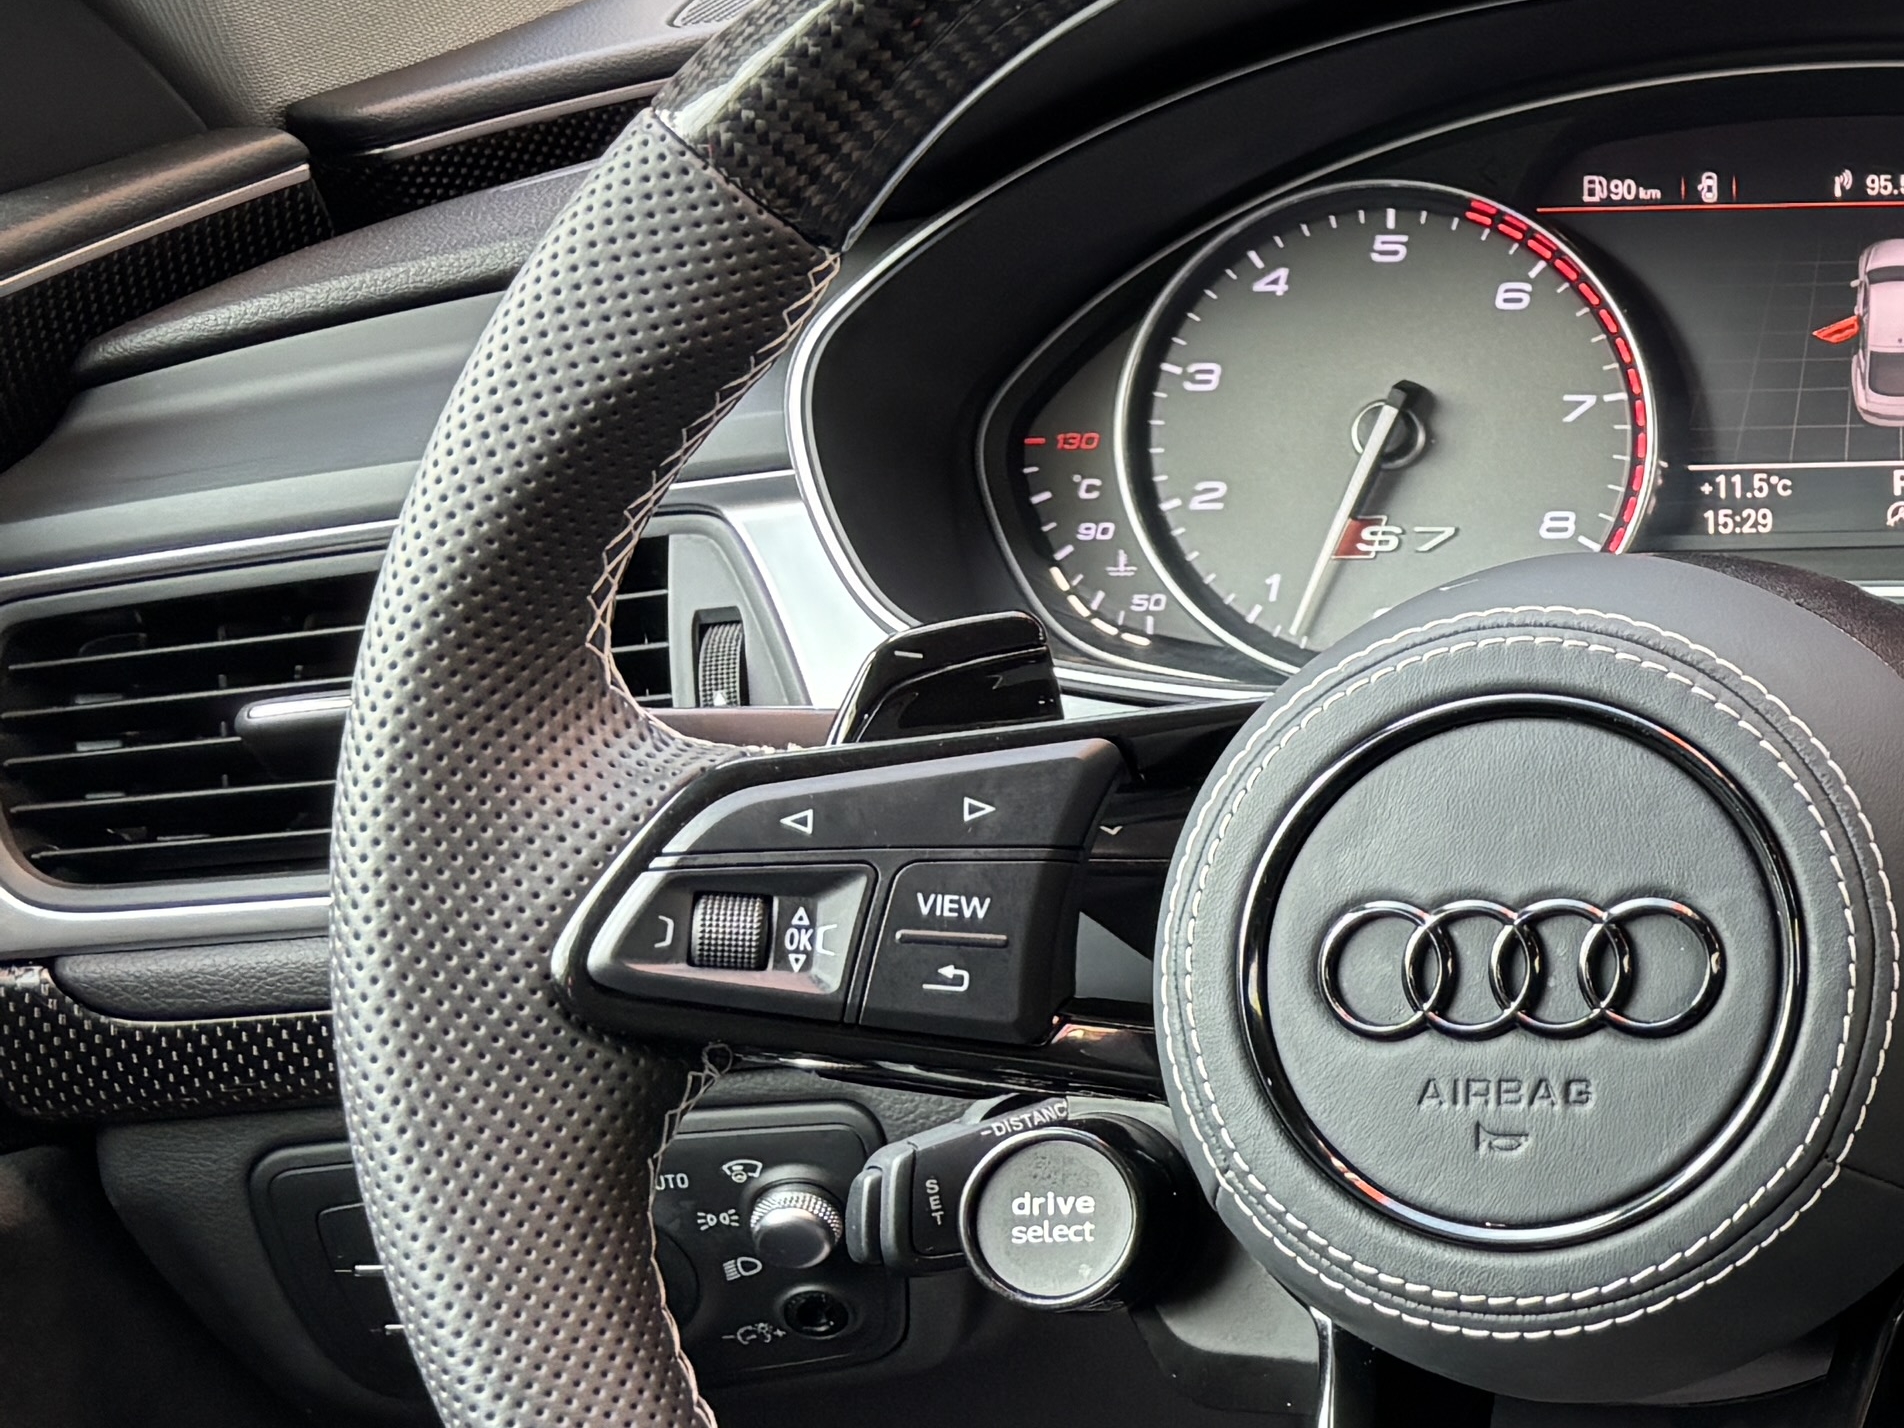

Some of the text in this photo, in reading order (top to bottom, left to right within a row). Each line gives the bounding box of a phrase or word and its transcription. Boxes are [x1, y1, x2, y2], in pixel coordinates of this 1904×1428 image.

[1370, 234, 1410, 263] 5
[1252, 268, 1290, 297] 4
[1494, 280, 1533, 310] 6
[1182, 361, 1222, 392] 3
[1561, 394, 1597, 423] 7
[1055, 431, 1100, 451] 130
[1189, 480, 1228, 511] 2
[1076, 521, 1116, 541] 90
[1538, 510, 1577, 541] 8
[1703, 508, 1773, 535] 15:29
[1355, 524, 1457, 552] S7
[1130, 593, 1167, 612] 50
[1263, 573, 1281, 603] 1
[916, 891, 991, 920] VIEW
[783, 925, 813, 951] OK
[1417, 1077, 1595, 1109] AIRBAG
[924, 1178, 945, 1227] SET
[1011, 1191, 1096, 1215] drive
[1011, 1220, 1096, 1245] select
